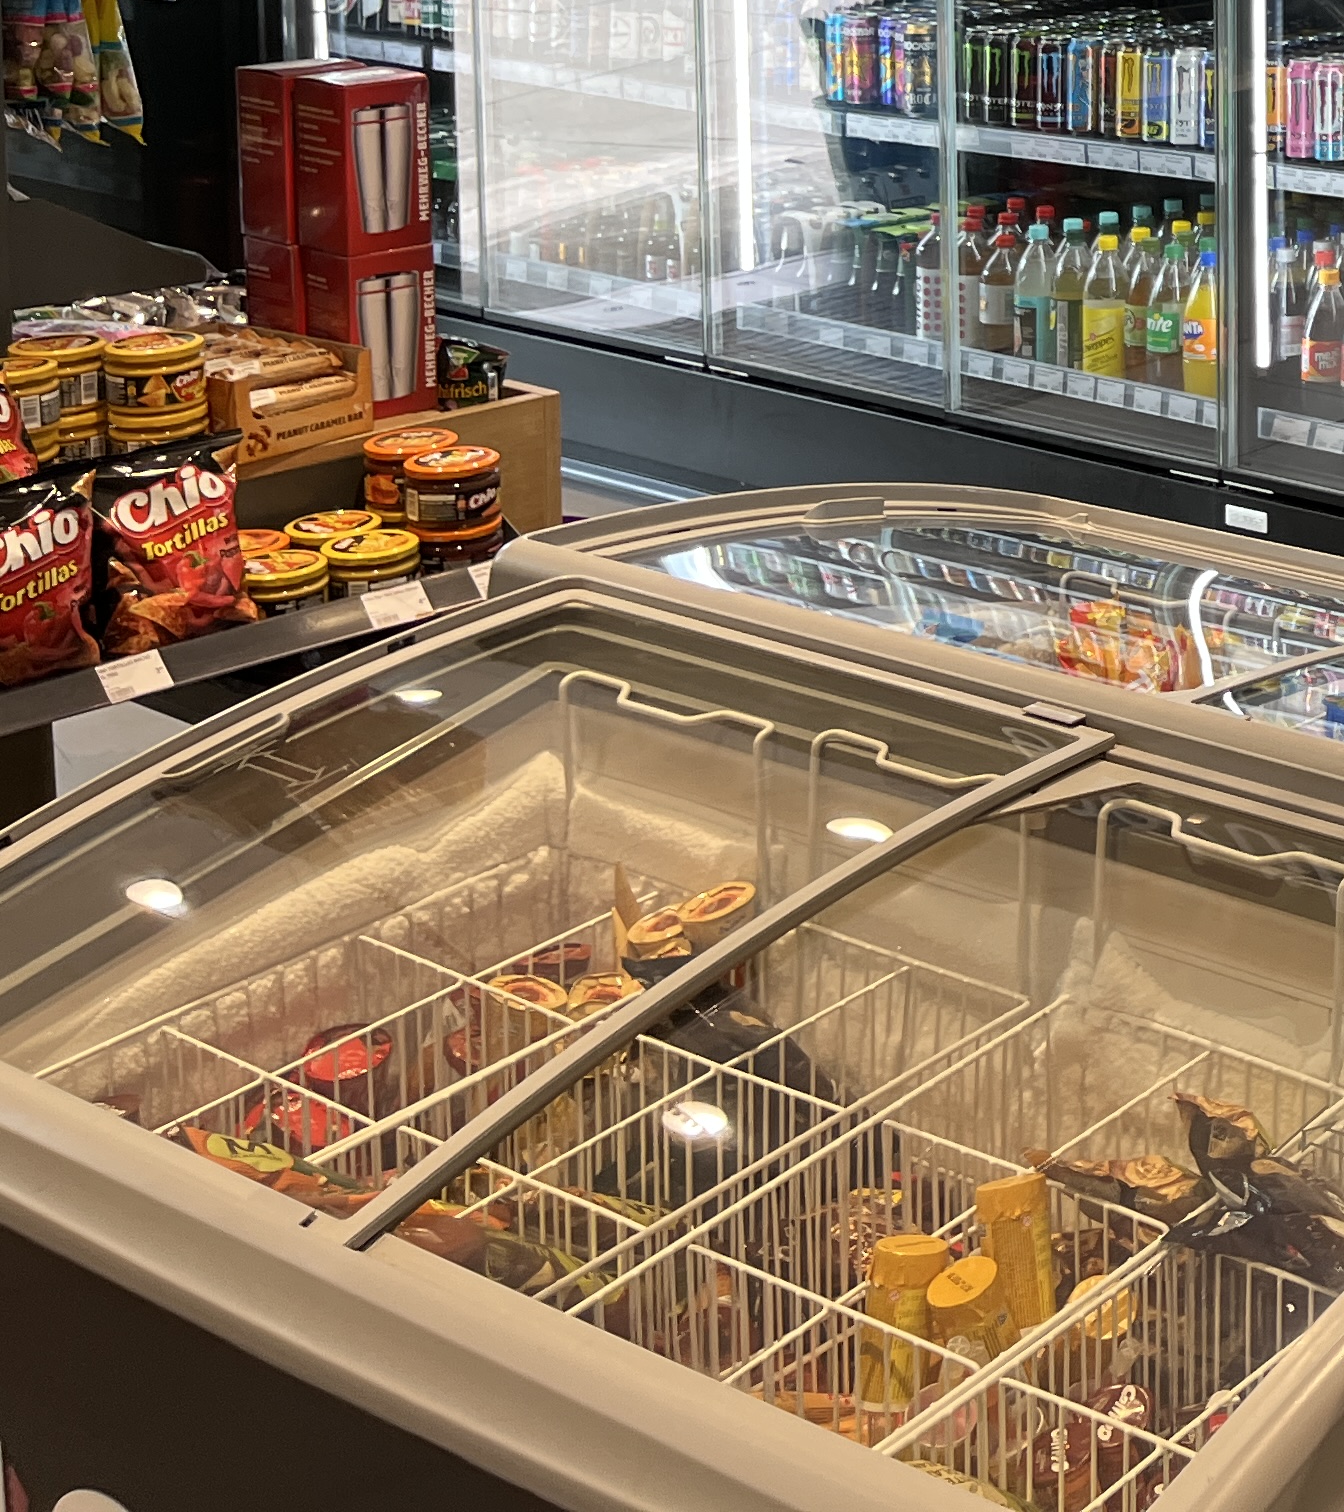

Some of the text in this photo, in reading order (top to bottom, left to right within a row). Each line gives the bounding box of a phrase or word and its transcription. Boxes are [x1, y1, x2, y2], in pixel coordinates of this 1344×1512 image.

[417, 102, 431, 221] MEHRWEG-BECHER
[422, 270, 435, 388] MEHRWEG-BECHER
[175, 371, 199, 387] Chio
[277, 411, 363, 441] PEANUT CARAMEL BAR
[117, 465, 226, 533] Chio
[142, 513, 229, 561] Tortillas
[0, 560, 79, 612] ortillas
